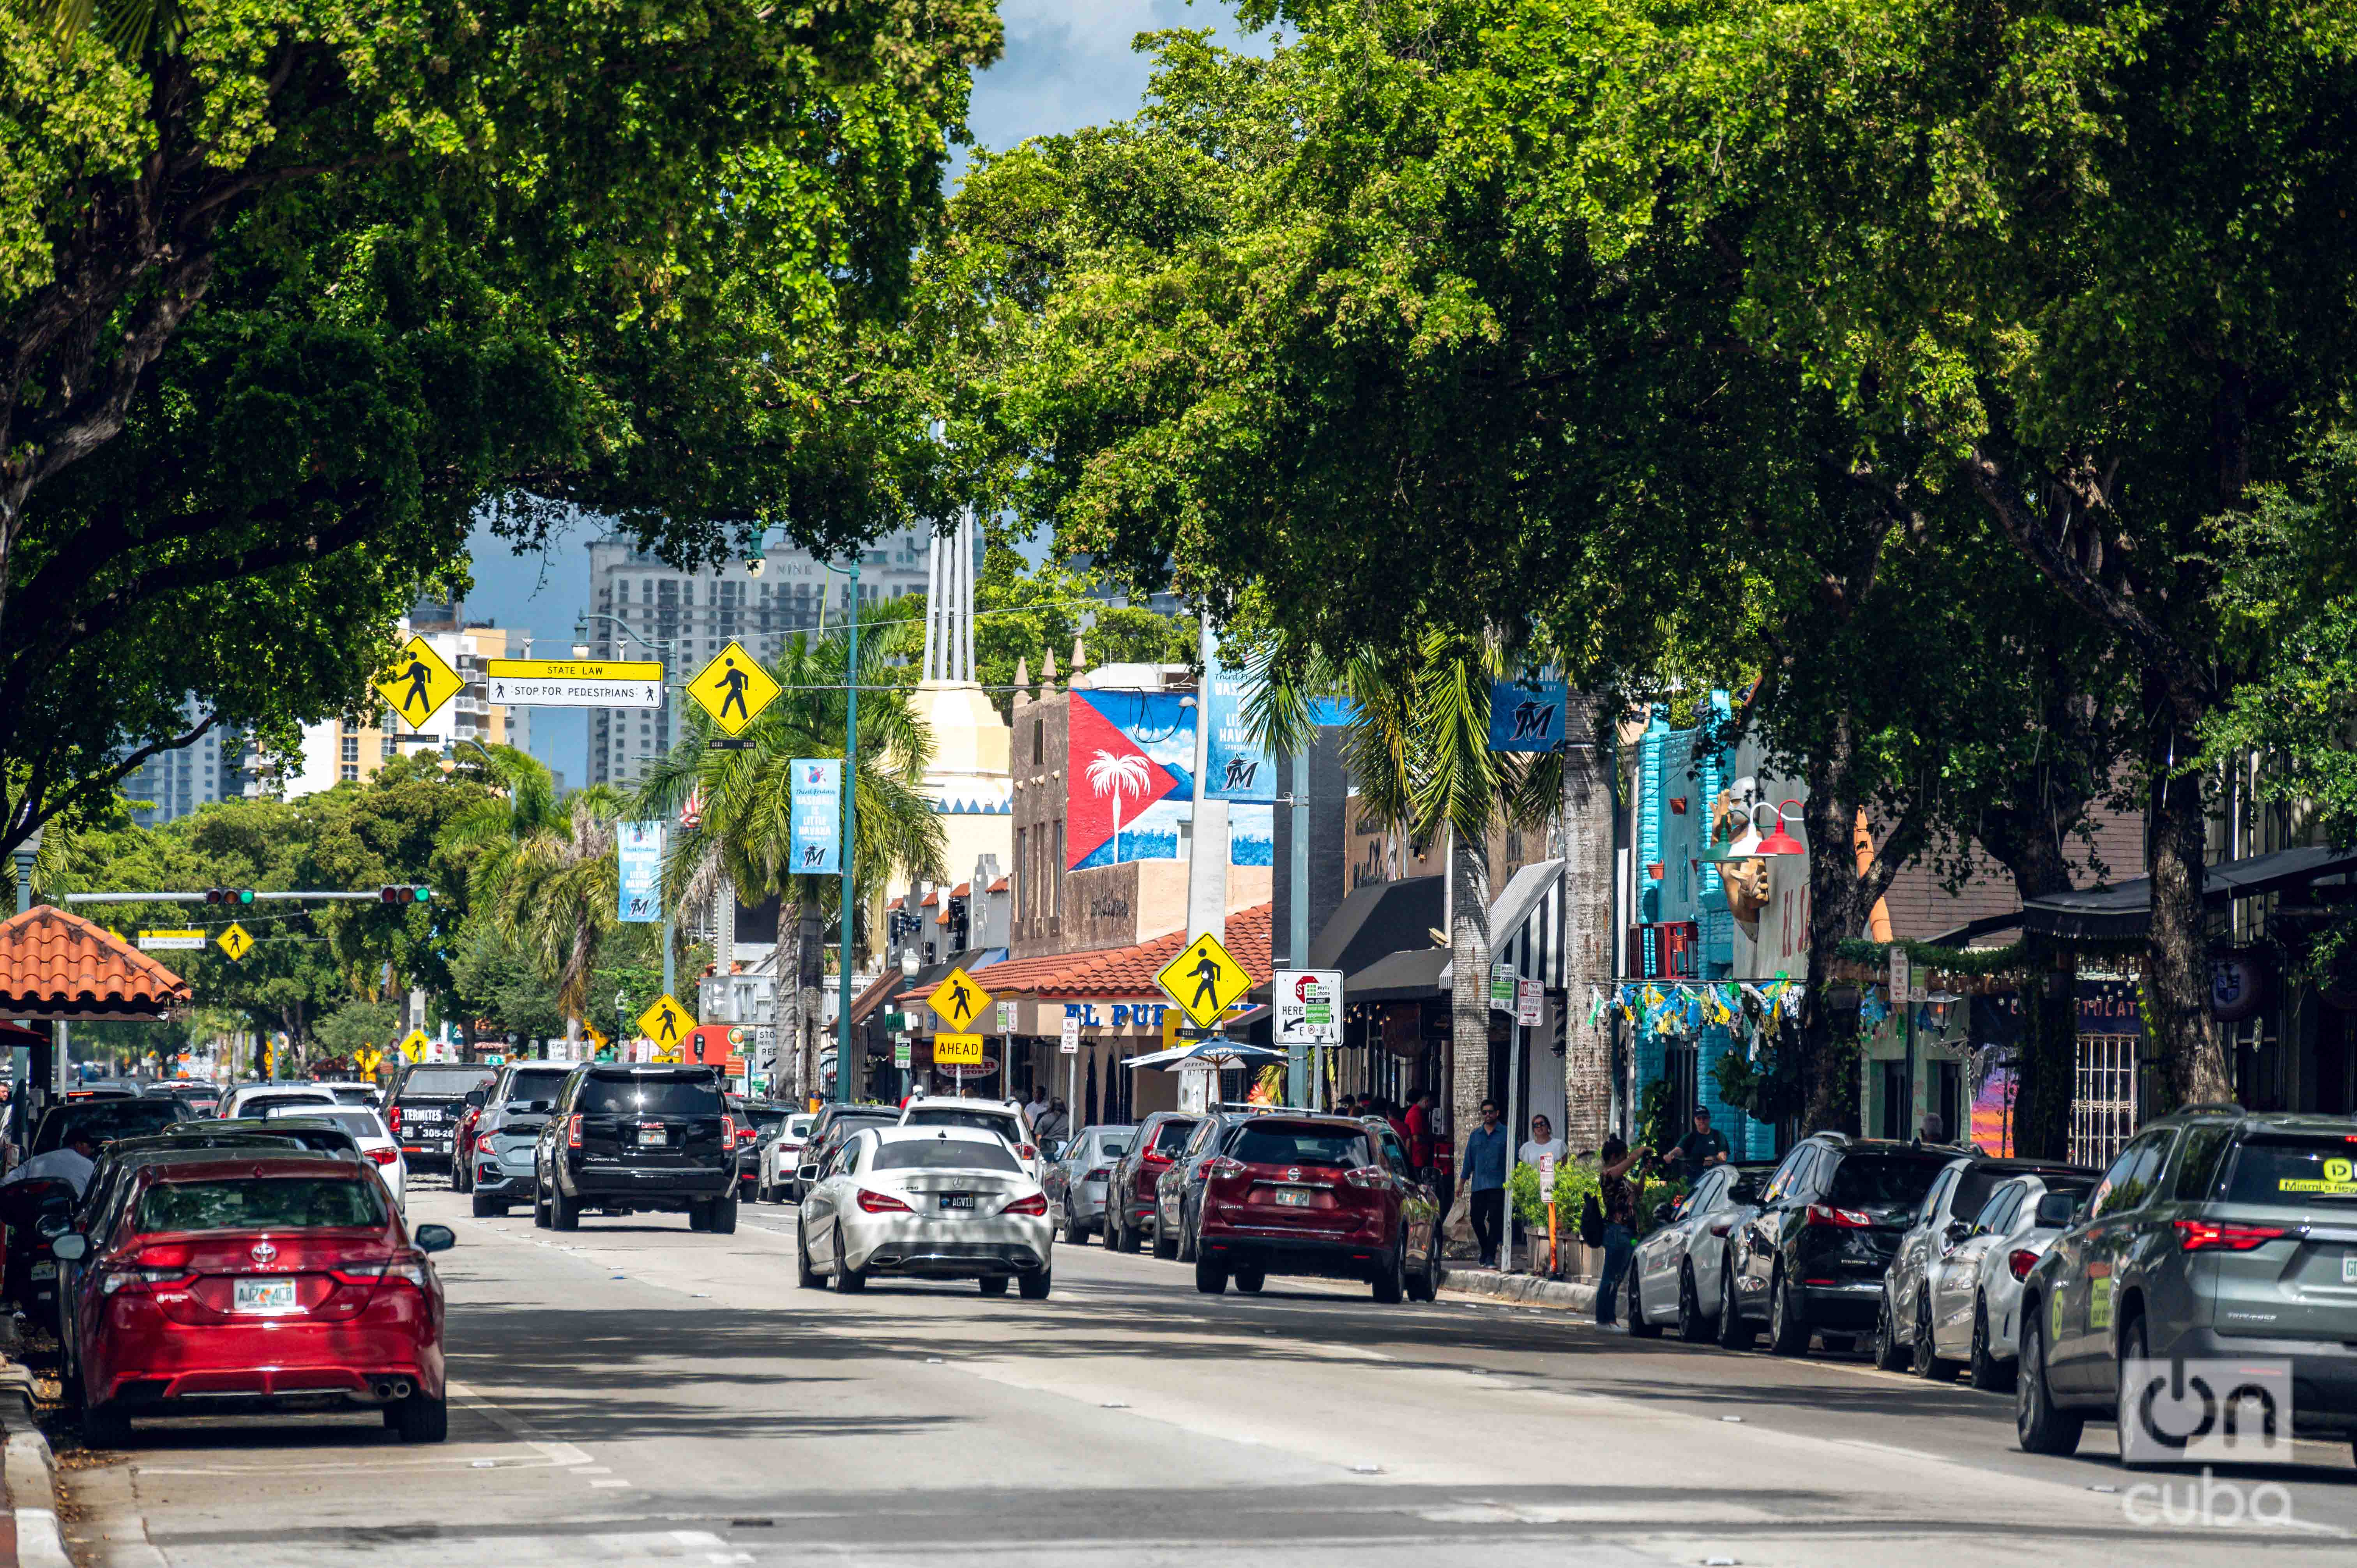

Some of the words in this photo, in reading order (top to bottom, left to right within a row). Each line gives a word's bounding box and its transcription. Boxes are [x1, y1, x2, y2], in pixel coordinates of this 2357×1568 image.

[776, 564, 812, 575] NINE
[515, 687, 538, 696] STOP
[542, 687, 561, 696] FOR
[568, 688, 634, 697] PEDESTRIANS
[1064, 1004, 1099, 1026] EL
[1282, 1006, 1304, 1015] HERE
[938, 1042, 979, 1055] AHEAD
[403, 1109, 442, 1121] TERMITES
[2285, 1180, 2332, 1192] Miami's
